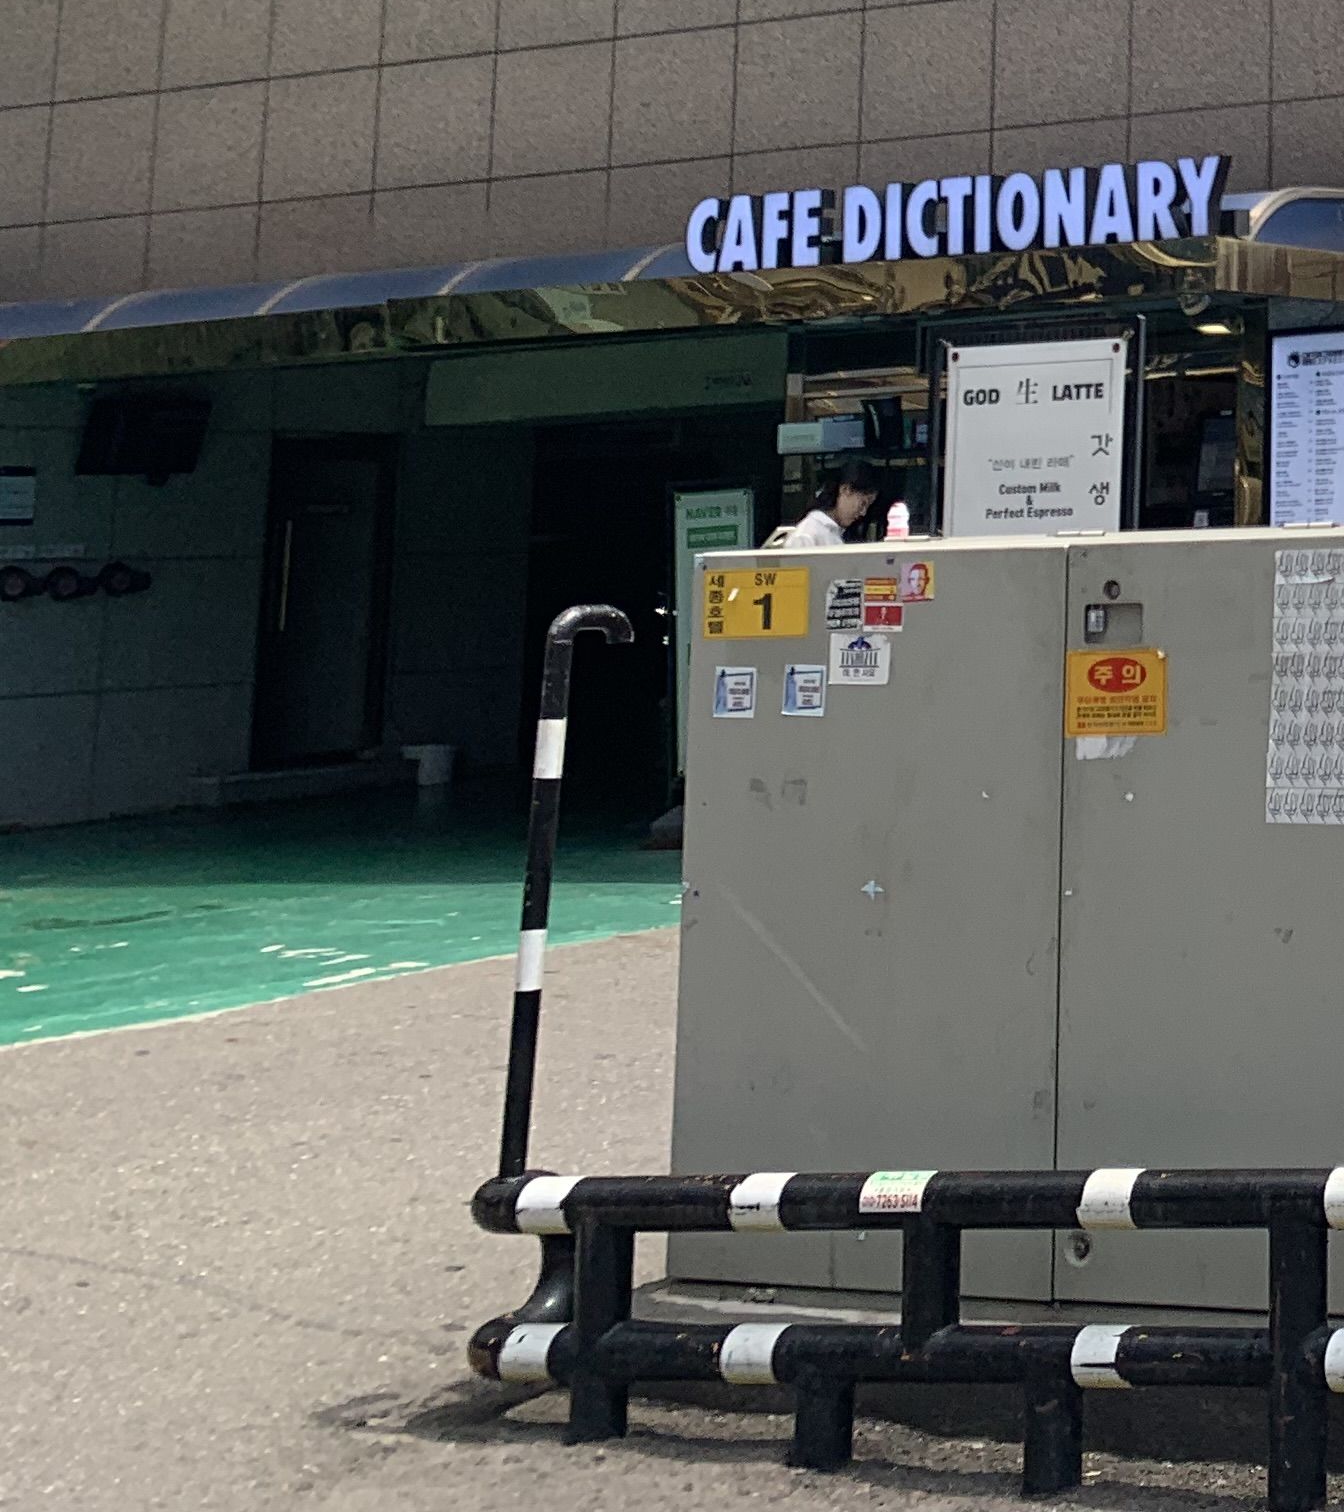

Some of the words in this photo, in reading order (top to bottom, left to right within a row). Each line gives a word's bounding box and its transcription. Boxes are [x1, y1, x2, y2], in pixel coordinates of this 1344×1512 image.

[685, 189, 821, 274] CAFE
[841, 154, 1222, 265] DICTIONARY
[963, 389, 1001, 406] GOD
[1015, 378, 1039, 405] 生
[1052, 383, 1104, 402] LATTE
[999, 483, 1037, 496] Custom
[985, 508, 1025, 520] Perfect
[1026, 507, 1074, 520] Espresso
[754, 573, 777, 587] SW
[752, 592, 772, 630] 1
